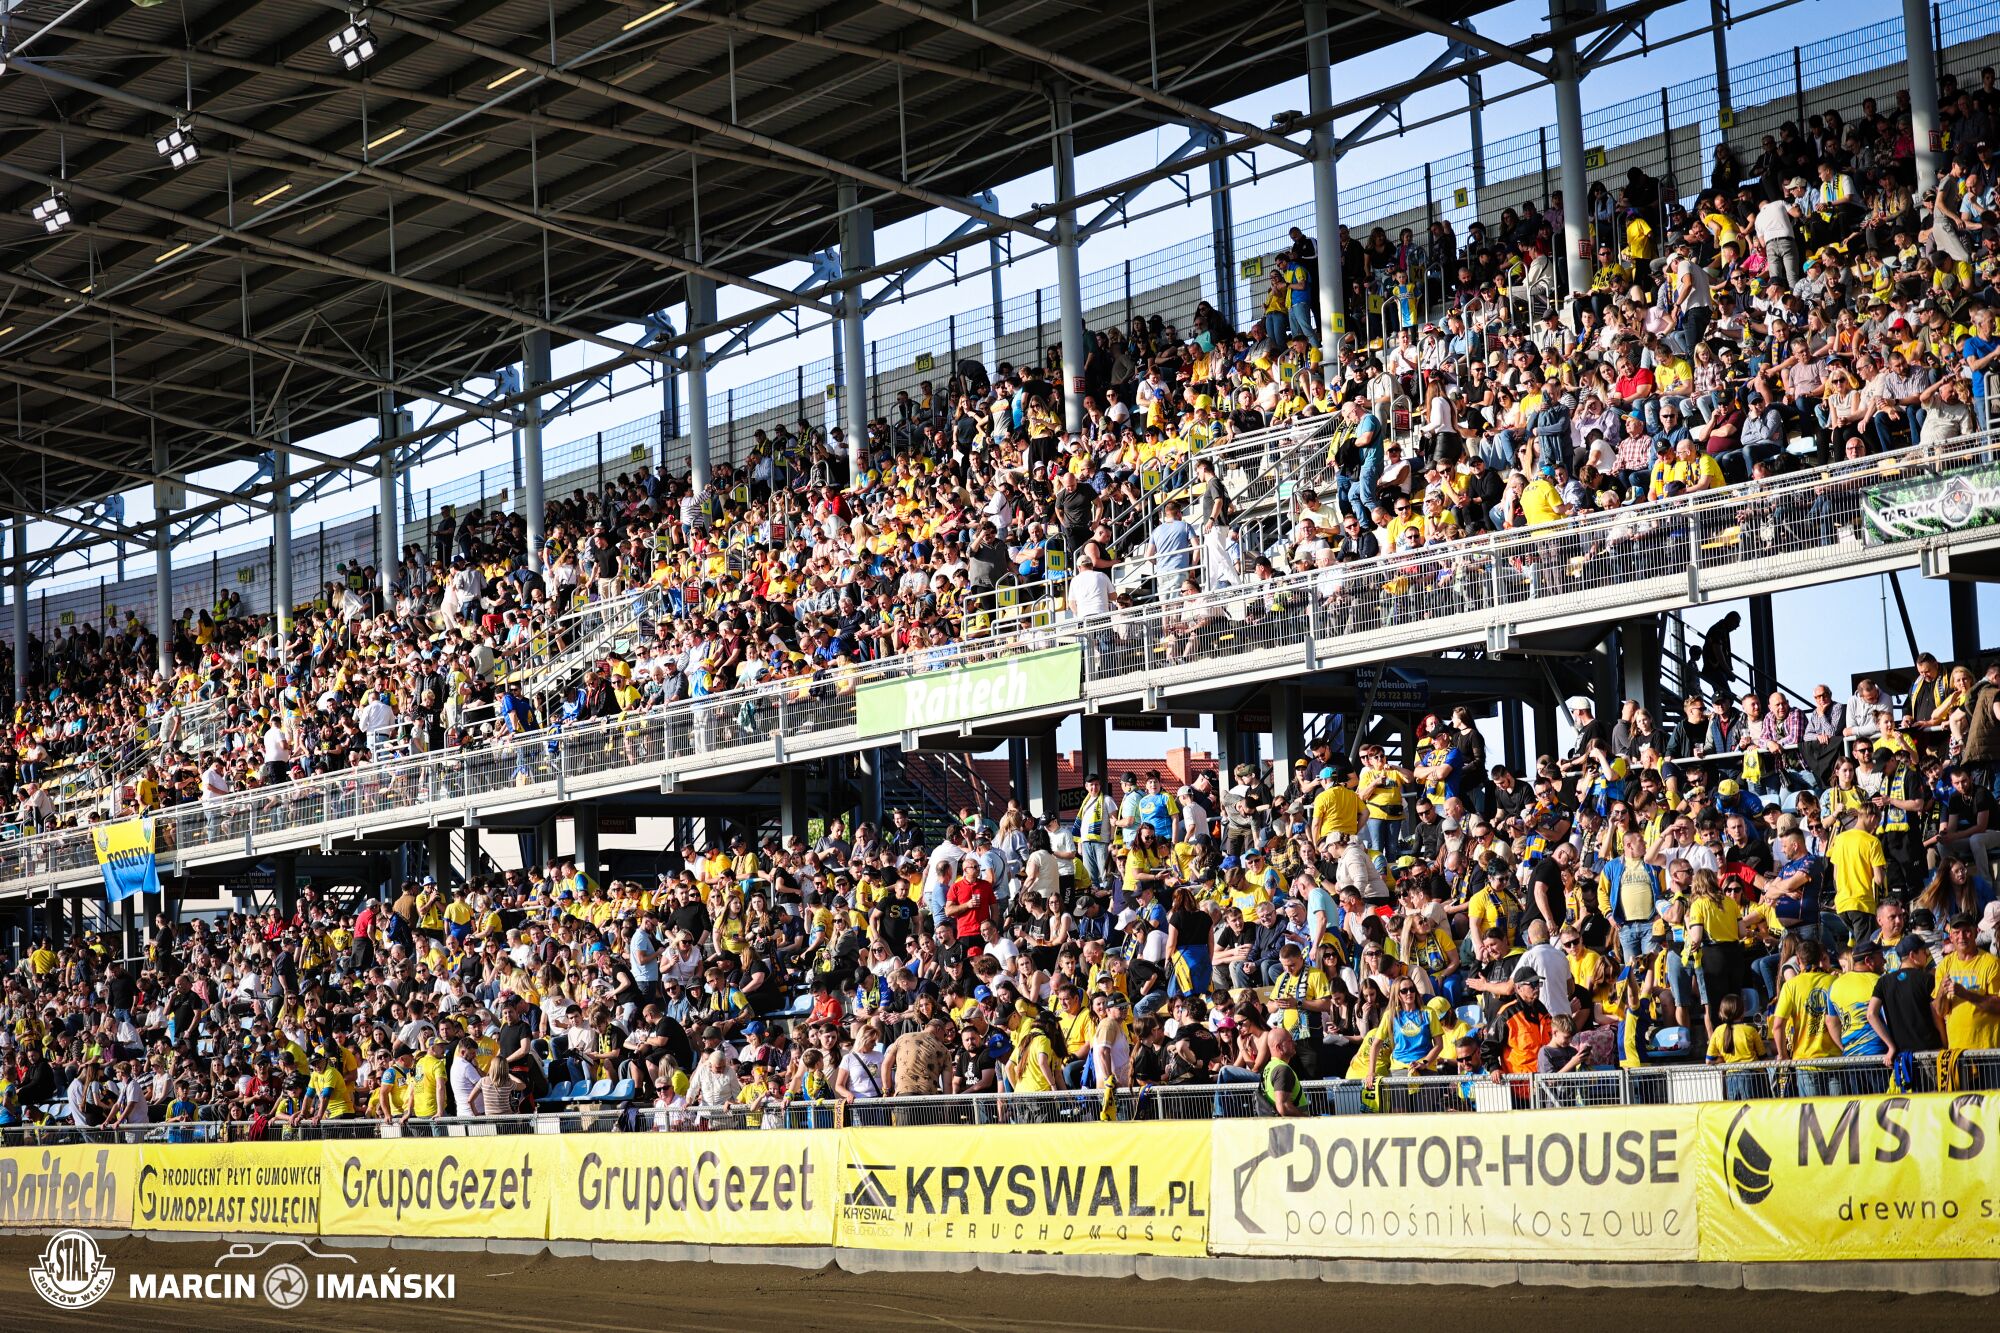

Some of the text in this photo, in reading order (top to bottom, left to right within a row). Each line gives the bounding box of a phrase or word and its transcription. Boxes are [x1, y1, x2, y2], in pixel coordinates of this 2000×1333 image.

[1148, 475, 1155, 486] V
[1881, 502, 1936, 521] TARTAK
[1051, 555, 1060, 566] III
[904, 658, 1028, 725] Raitech
[889, 904, 910, 920] SG
[1798, 1094, 2000, 1167] MS S
[163, 1165, 321, 1187] PRODUCENT PŁYT GUMOWYCH
[1286, 1129, 1680, 1193] DOKTOR-HOUSE
[0, 1150, 117, 1223] Raitech
[343, 1153, 533, 1221] GrupaGezet
[578, 1147, 815, 1226] GrupaGezet
[905, 1164, 1205, 1217] KRYSWAL.PL
[249, 1196, 319, 1228] SULĘCIN
[843, 1206, 896, 1222] KRYSWAL
[1285, 1199, 1681, 1241] podnośniki koszowe
[1839, 1196, 2000, 1221] drewno s
[904, 1221, 1205, 1242] NIERUCHOMOŚCI
